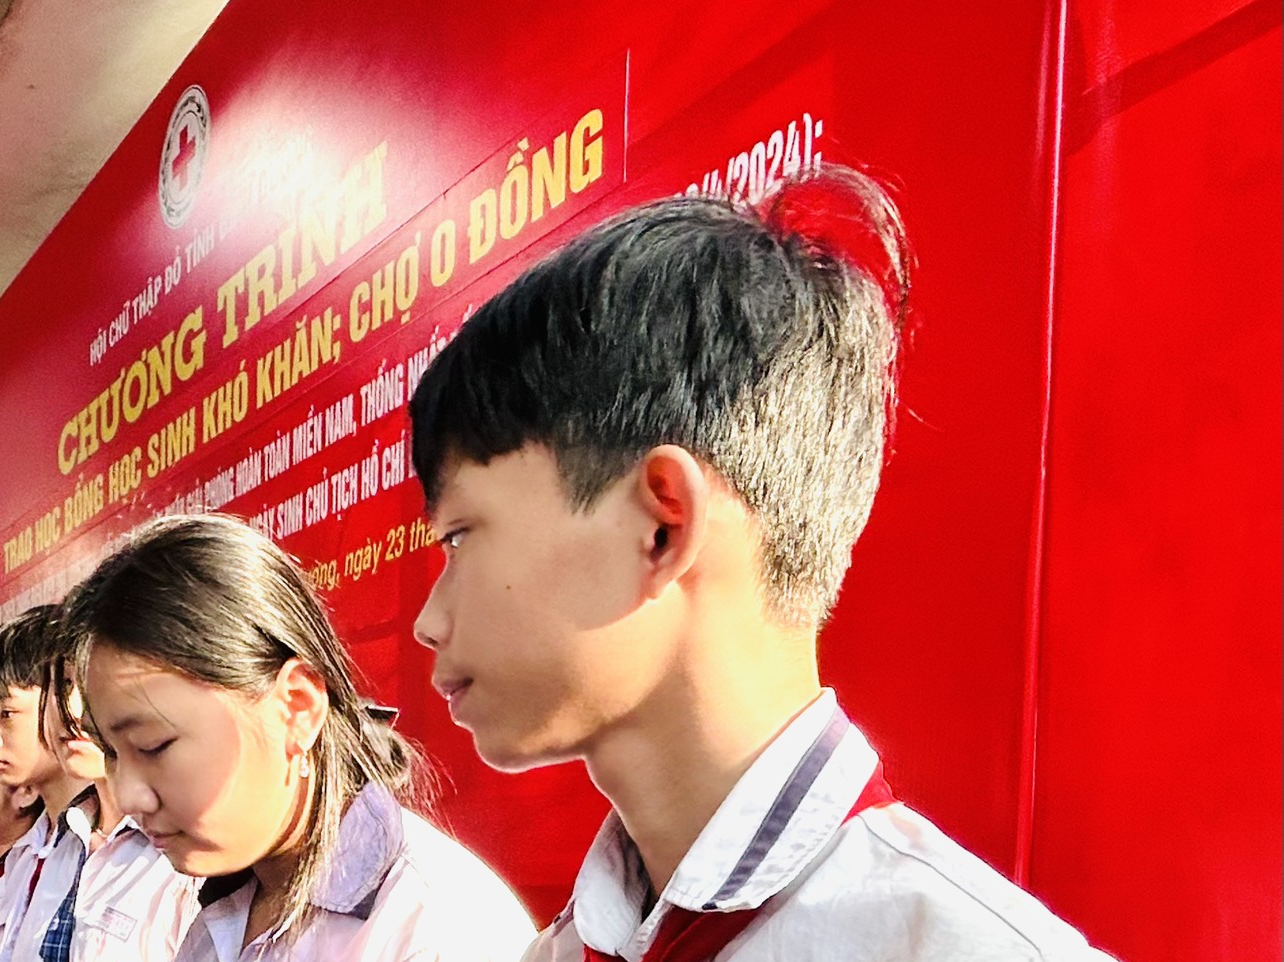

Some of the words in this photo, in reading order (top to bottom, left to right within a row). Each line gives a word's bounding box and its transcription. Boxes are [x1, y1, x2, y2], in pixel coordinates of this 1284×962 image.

[4, 527, 32, 575] TRAO
[35, 507, 61, 554] HỌC
[64, 472, 104, 534] BỔNG
[109, 447, 142, 504] HỌC
[147, 407, 196, 478] SINH
[203, 360, 248, 444] KHÓ
[257, 307, 341, 409] KHĂN;
[349, 233, 420, 342] CHỢ
[467, 108, 603, 265] ĐỒNG
[58, 306, 207, 475] CHƯƠNG
[325, 393, 357, 446] NAM,
[360, 358, 404, 426] THỐNG
[360, 440, 379, 499] HỒ
[382, 431, 406, 490] CHÍ
[344, 538, 382, 581] ngày
[385, 525, 405, 561] 23
